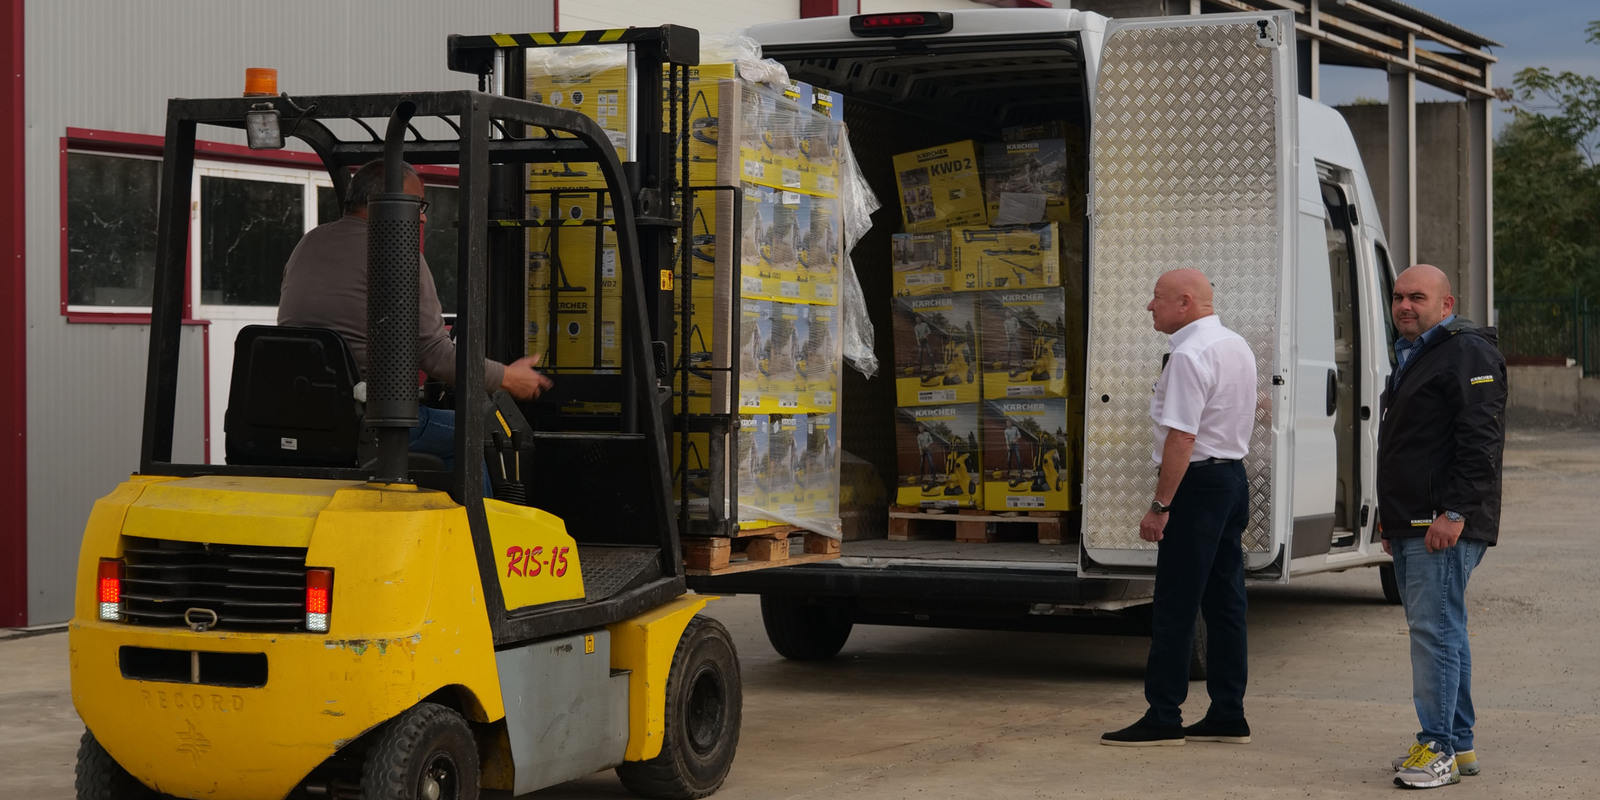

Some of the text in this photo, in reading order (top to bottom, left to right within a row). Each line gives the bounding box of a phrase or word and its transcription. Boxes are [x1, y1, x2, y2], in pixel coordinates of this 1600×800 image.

[931, 157, 972, 176] KWD 2
[966, 272, 975, 280] 3
[140, 689, 244, 712] RECORD
